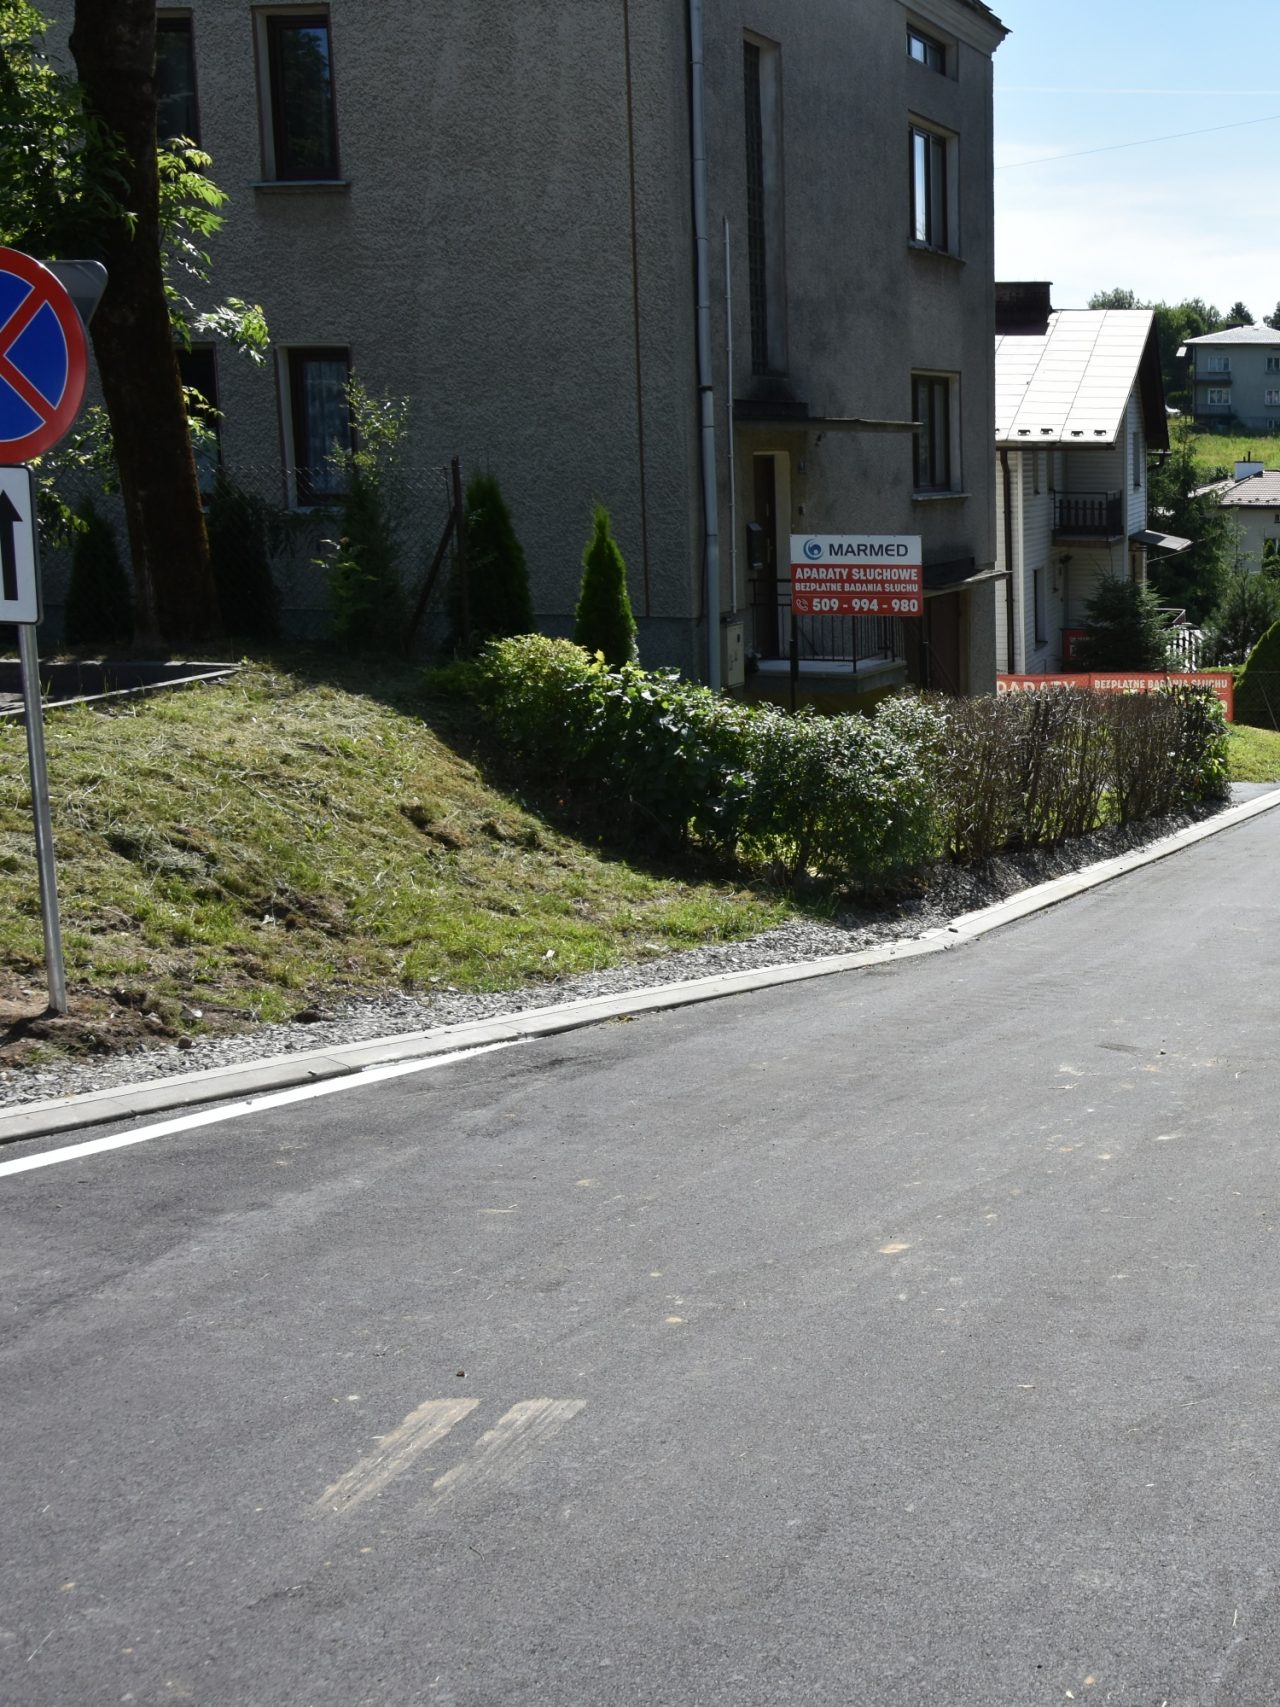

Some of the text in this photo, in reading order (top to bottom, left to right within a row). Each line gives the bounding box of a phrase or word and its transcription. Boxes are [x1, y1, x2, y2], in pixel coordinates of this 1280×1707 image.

[829, 543, 909, 557] MARMED
[795, 567, 918, 580] APARATY SŁUCHOWE
[795, 583, 918, 592] BEZPŁATNE BADANIA SŁUCHU
[812, 598, 839, 611] 509
[852, 599, 879, 611] 994
[891, 599, 918, 612] 980
